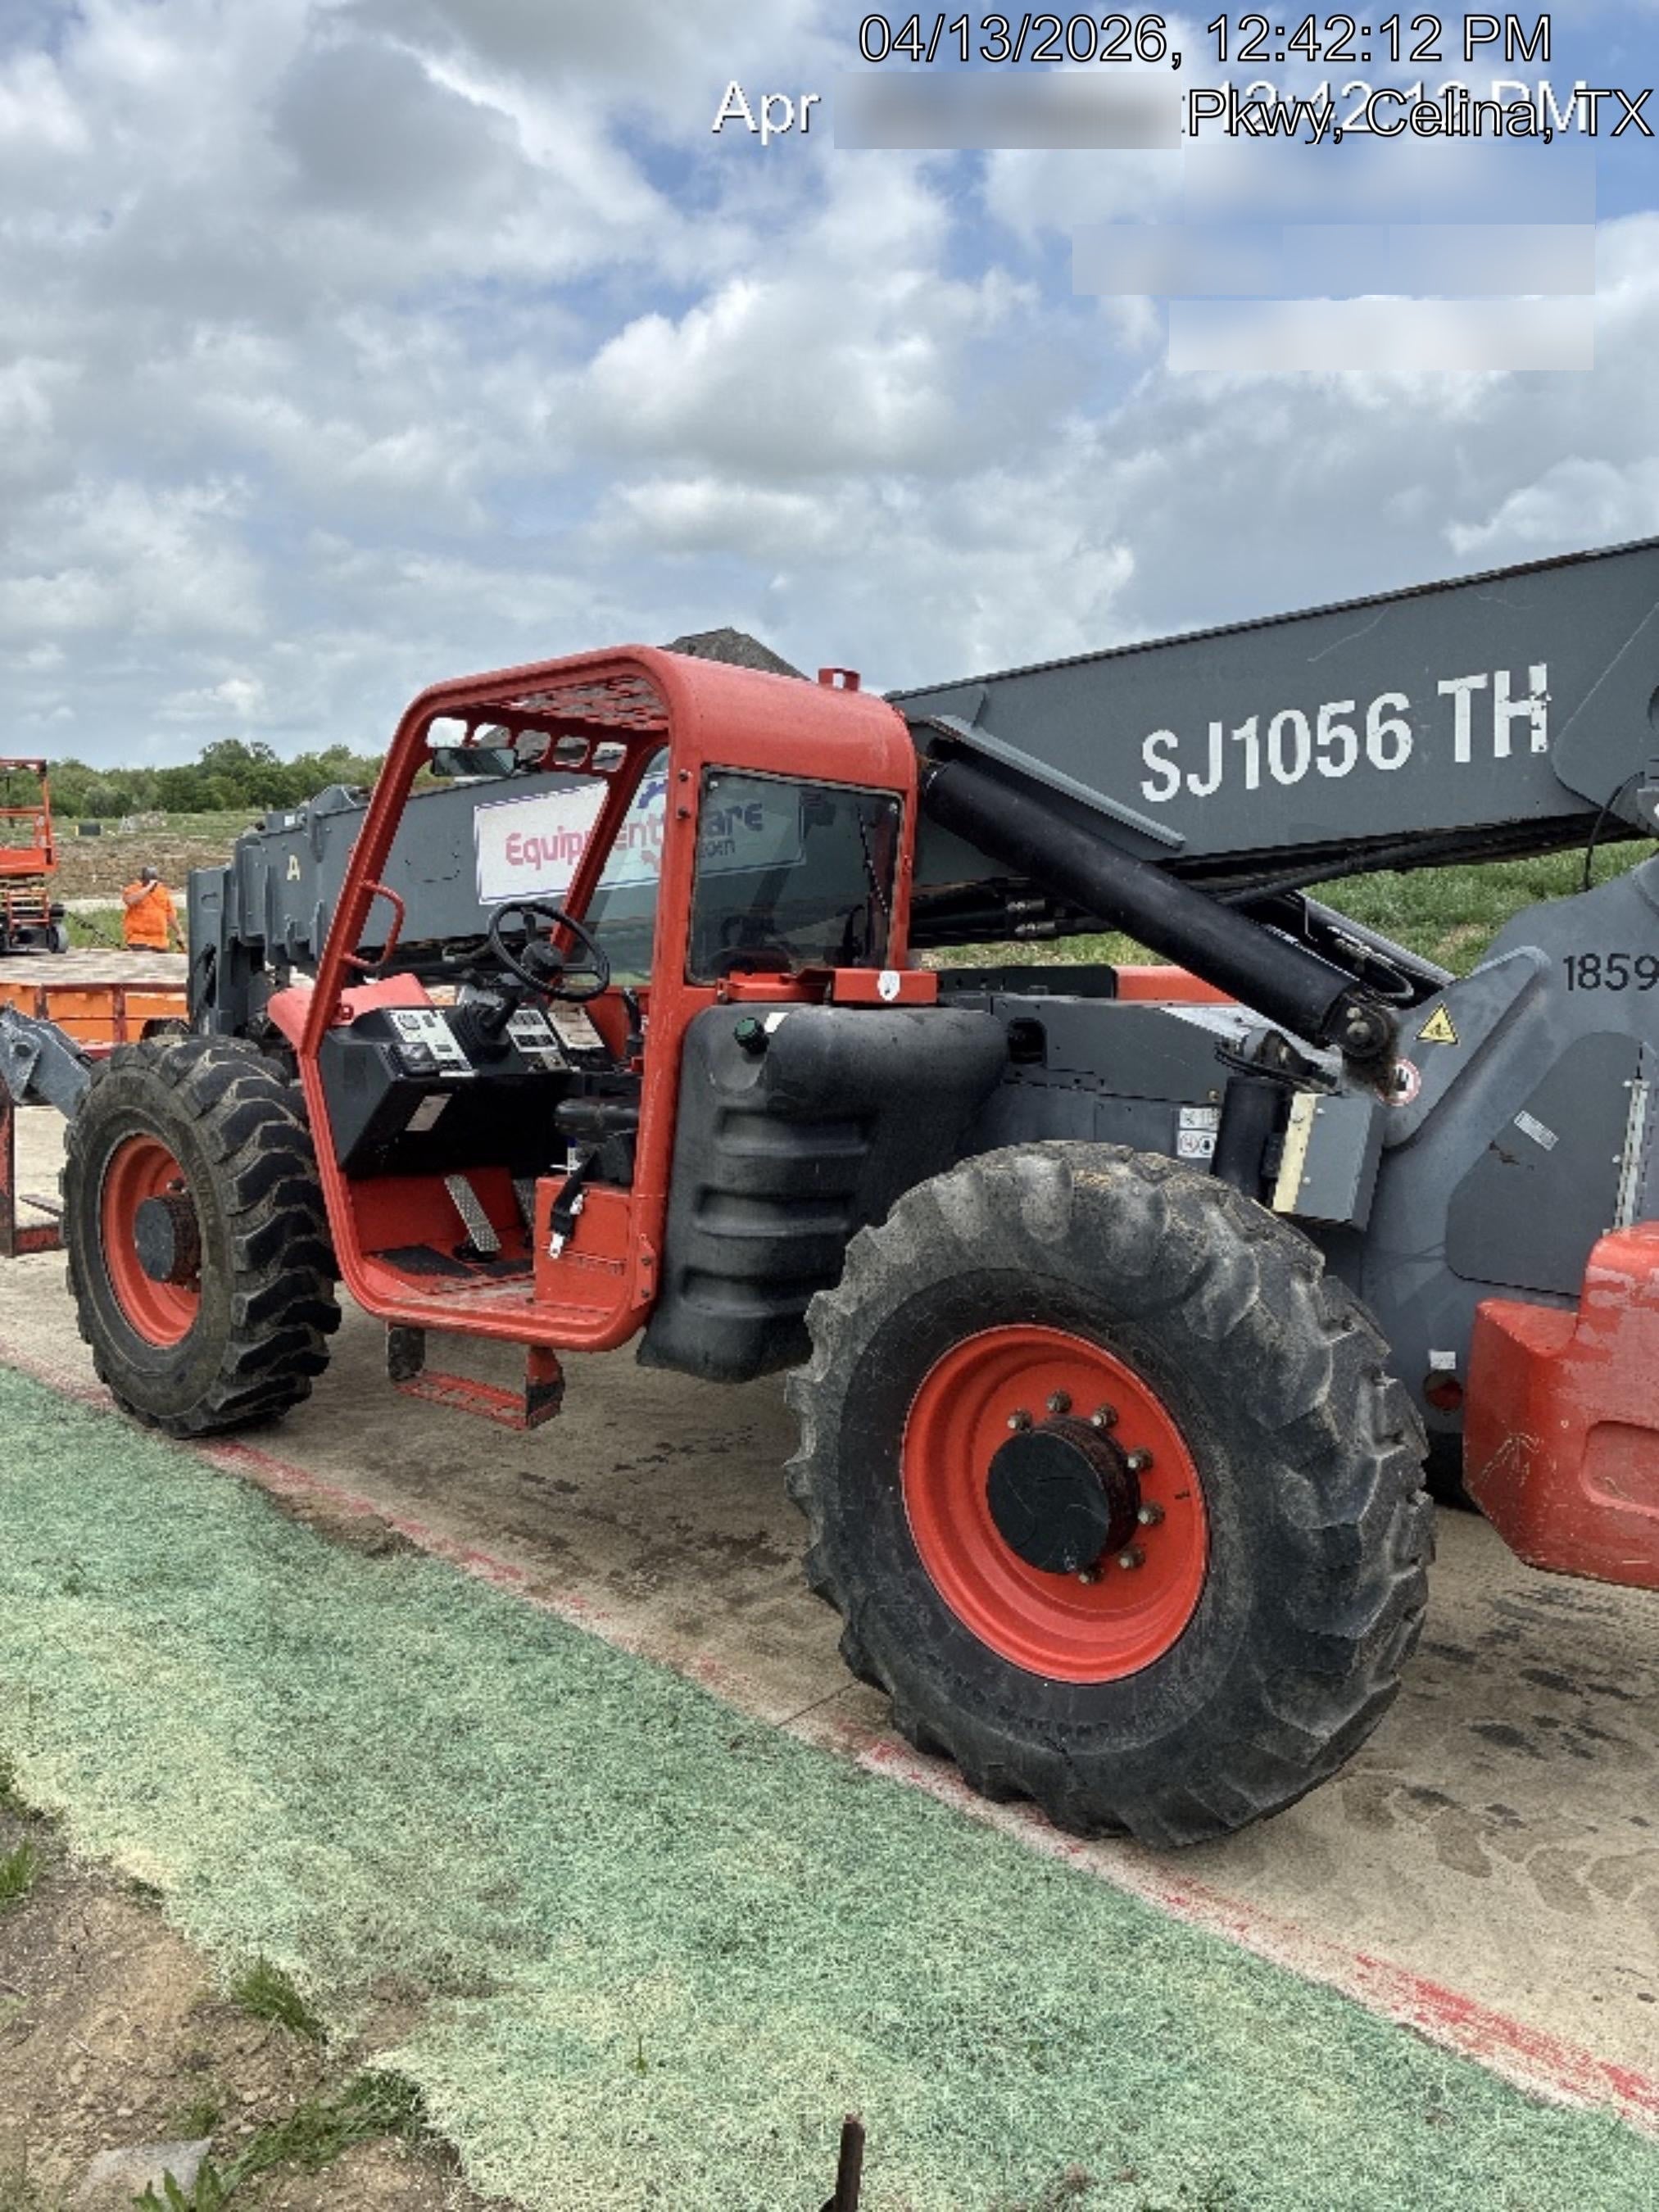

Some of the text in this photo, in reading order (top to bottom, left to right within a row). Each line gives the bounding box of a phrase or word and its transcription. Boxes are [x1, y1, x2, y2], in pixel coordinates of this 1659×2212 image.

[1139, 662, 1549, 803] SJ1056 TH
[287, 854, 301, 881] A
[1562, 953, 1659, 991] 1859
